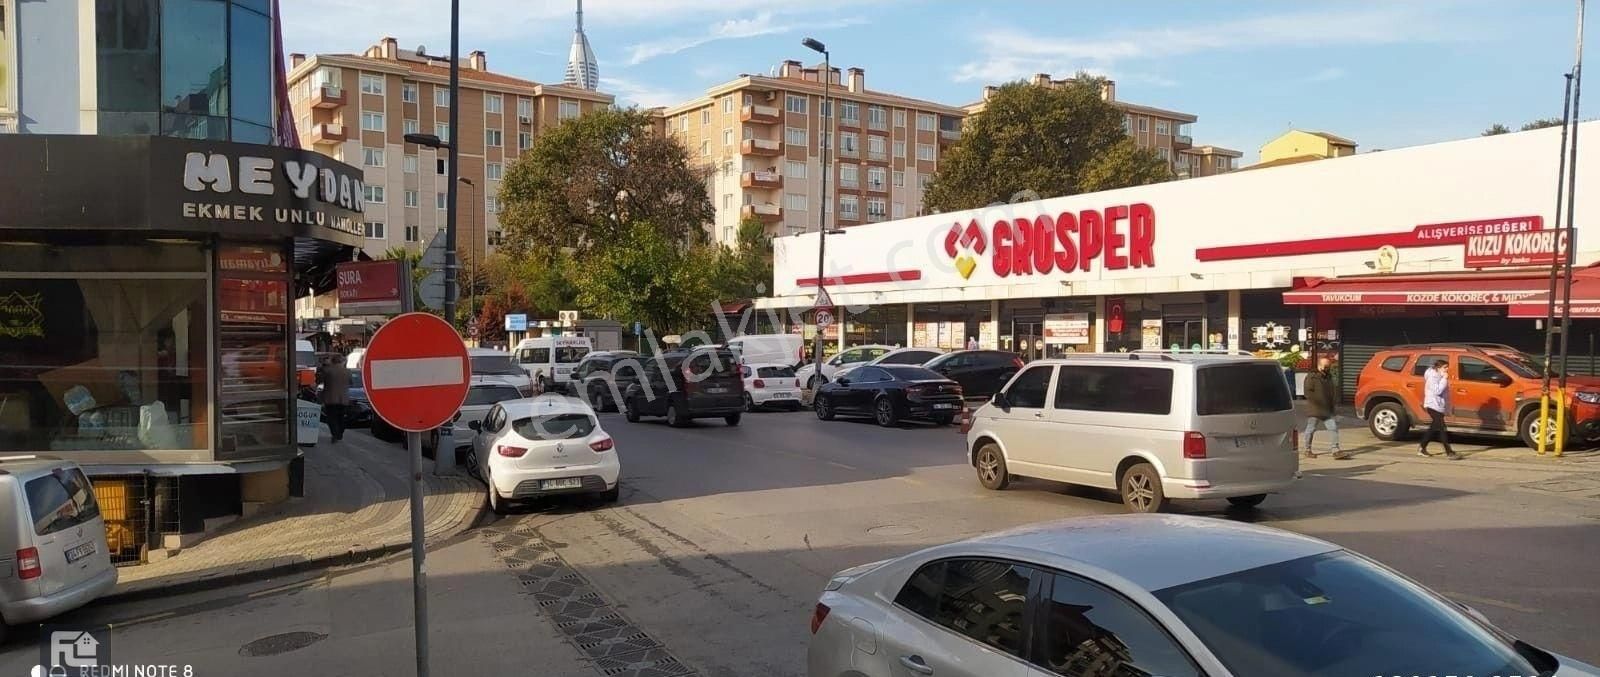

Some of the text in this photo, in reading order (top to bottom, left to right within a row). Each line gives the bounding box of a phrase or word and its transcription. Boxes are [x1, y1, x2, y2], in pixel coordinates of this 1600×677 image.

[183, 152, 365, 212] MEYDAN
[183, 202, 264, 221] EKMEK
[275, 208, 325, 226] UNLU
[992, 202, 1156, 278] GROSPER
[1467, 235, 1503, 256] KUZU
[817, 313, 830, 324] 20
